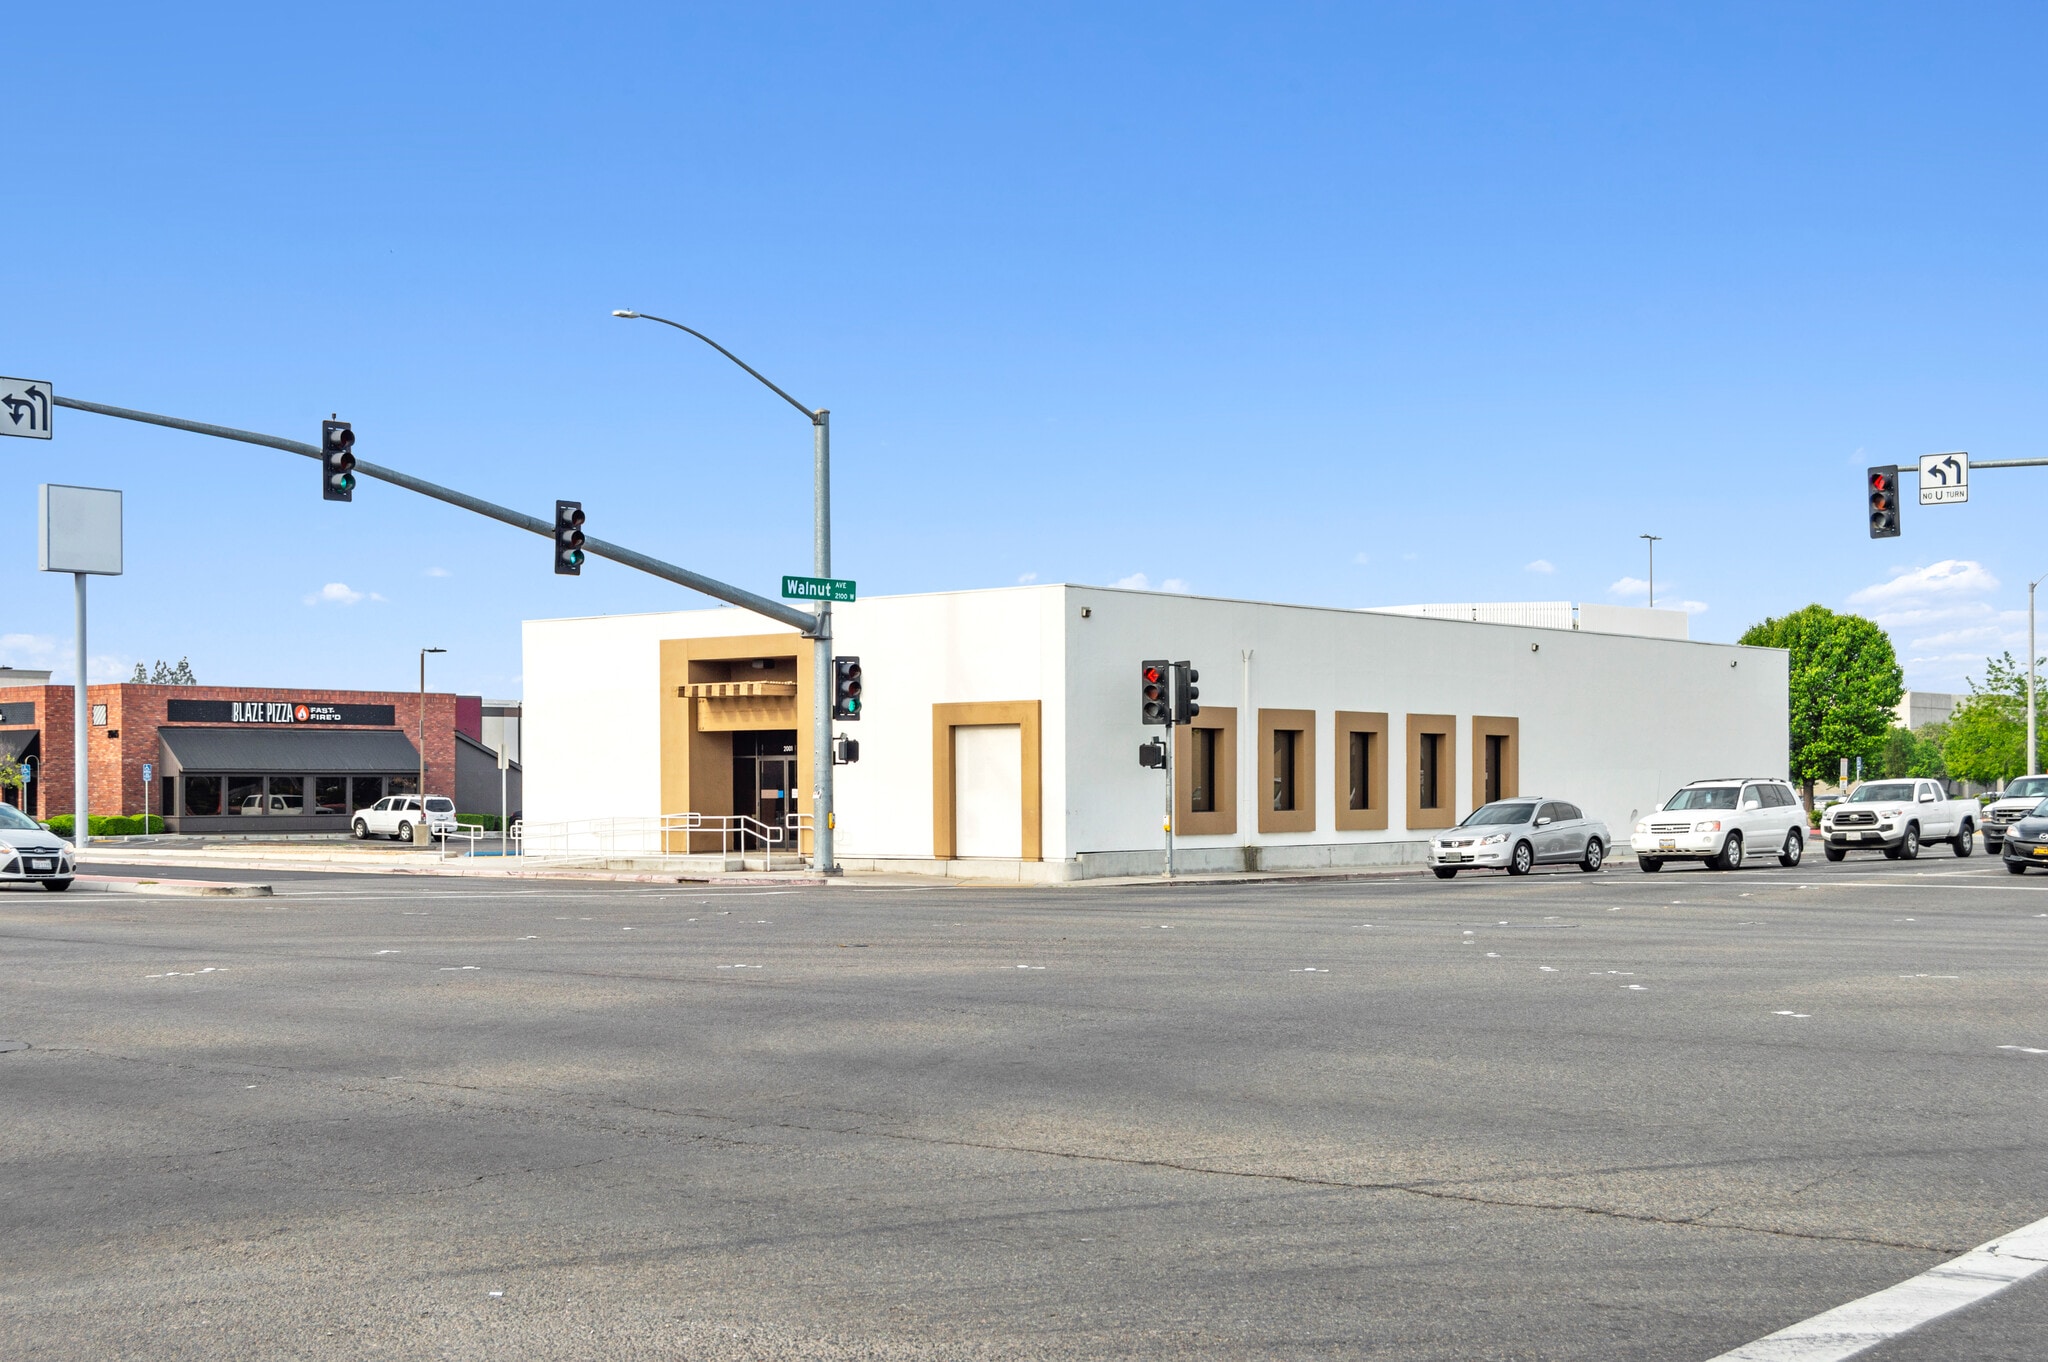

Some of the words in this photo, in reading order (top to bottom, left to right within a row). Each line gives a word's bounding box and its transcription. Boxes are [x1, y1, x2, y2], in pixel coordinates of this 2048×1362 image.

[1935, 491, 1943, 500] U
[787, 579, 831, 597] Walnut
[232, 702, 264, 722] BLAZE
[266, 702, 294, 723] PIZZA
